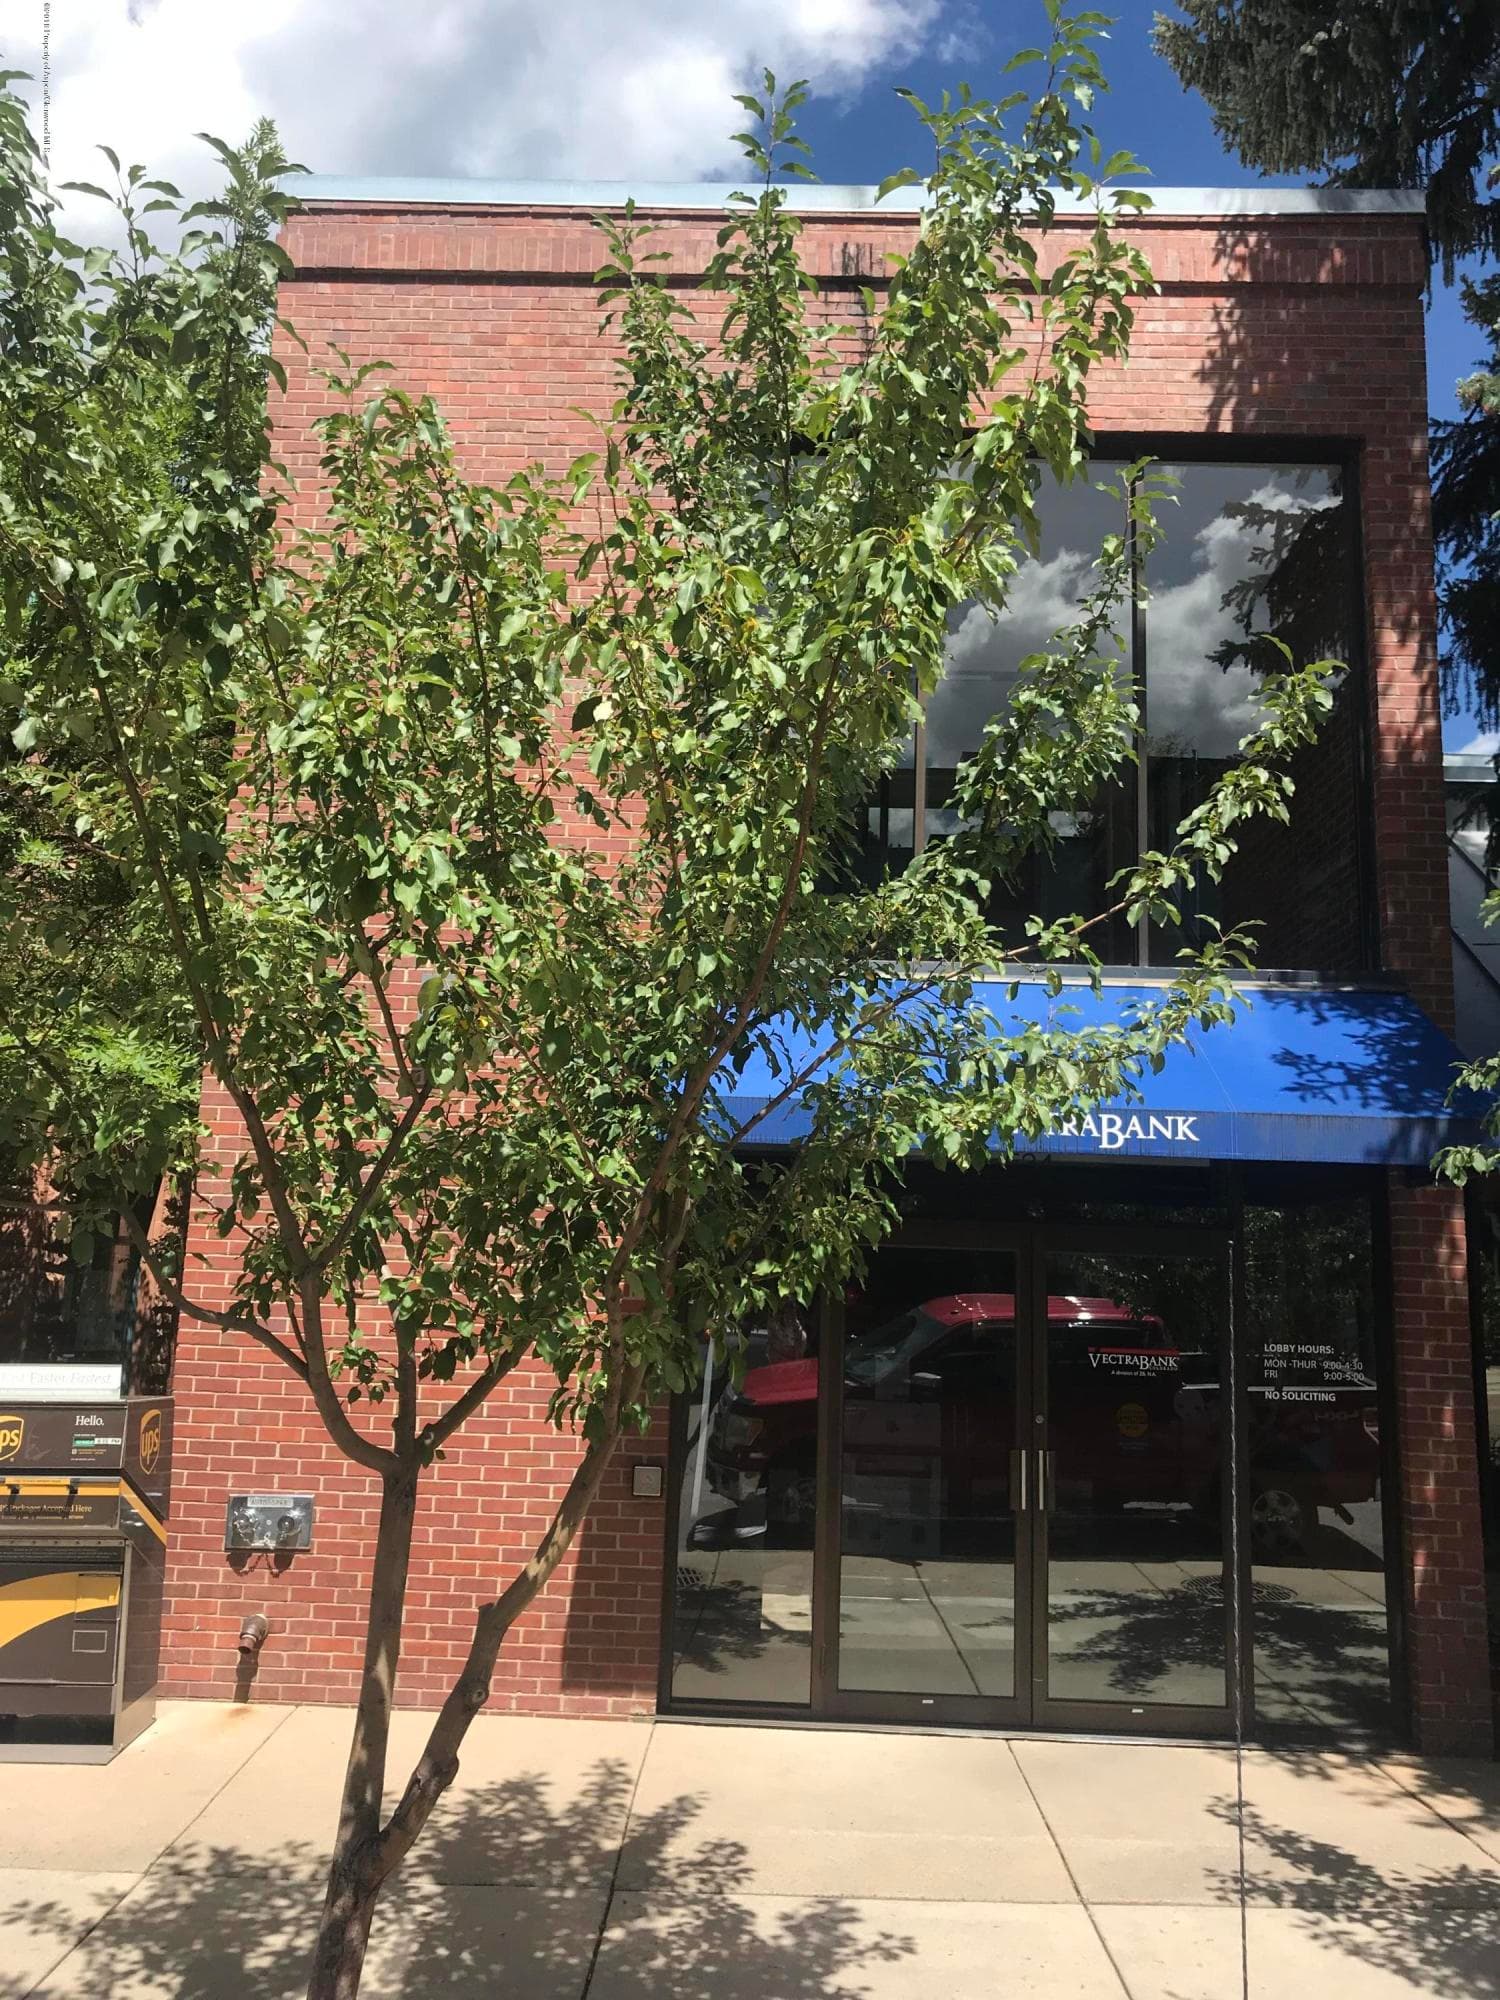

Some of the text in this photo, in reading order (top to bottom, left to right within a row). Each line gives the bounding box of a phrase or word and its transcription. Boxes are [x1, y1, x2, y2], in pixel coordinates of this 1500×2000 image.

[1012, 1112, 1200, 1149] TRABANK
[1264, 1343, 1335, 1354] LOBBY HOURS:
[1089, 1353, 1178, 1370] VECTRABANK
[1264, 1359, 1287, 1369] MON
[1264, 1369, 1365, 1381] FRI 9:00-5:00
[1264, 1390, 1336, 1402] NO SOLICITING
[75, 1415, 105, 1426] Hello.
[0, 1429, 20, 1453] ps
[141, 1428, 161, 1465] ups
[75, 1503, 92, 1513] Here
